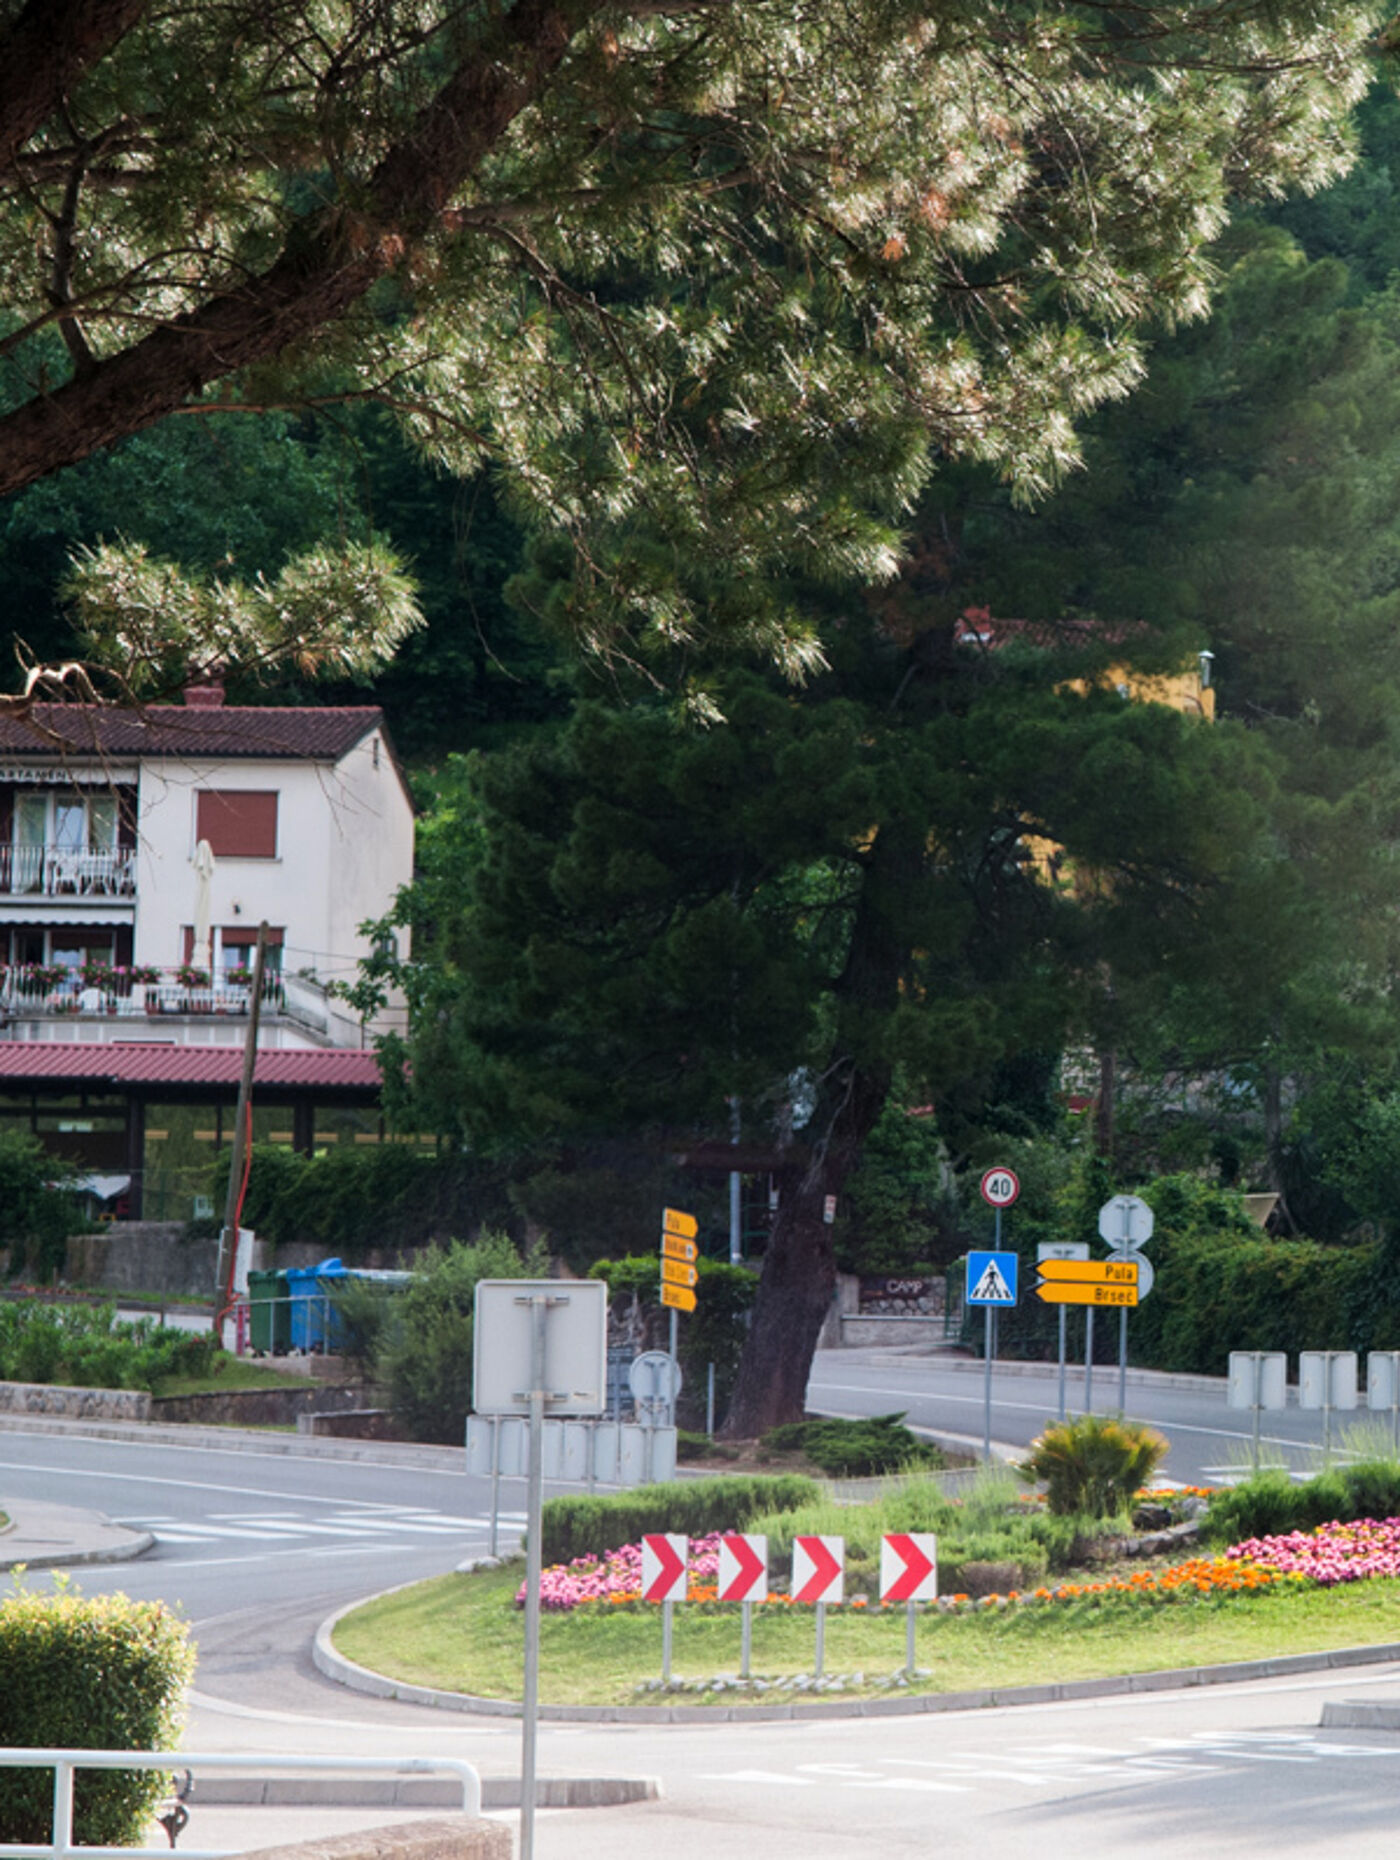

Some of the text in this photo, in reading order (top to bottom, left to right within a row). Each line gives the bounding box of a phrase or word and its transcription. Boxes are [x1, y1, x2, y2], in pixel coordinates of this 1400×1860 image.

[989, 1179, 1012, 1197] 40
[1105, 1265, 1133, 1280] Pula
[886, 1280, 923, 1294] CAMP
